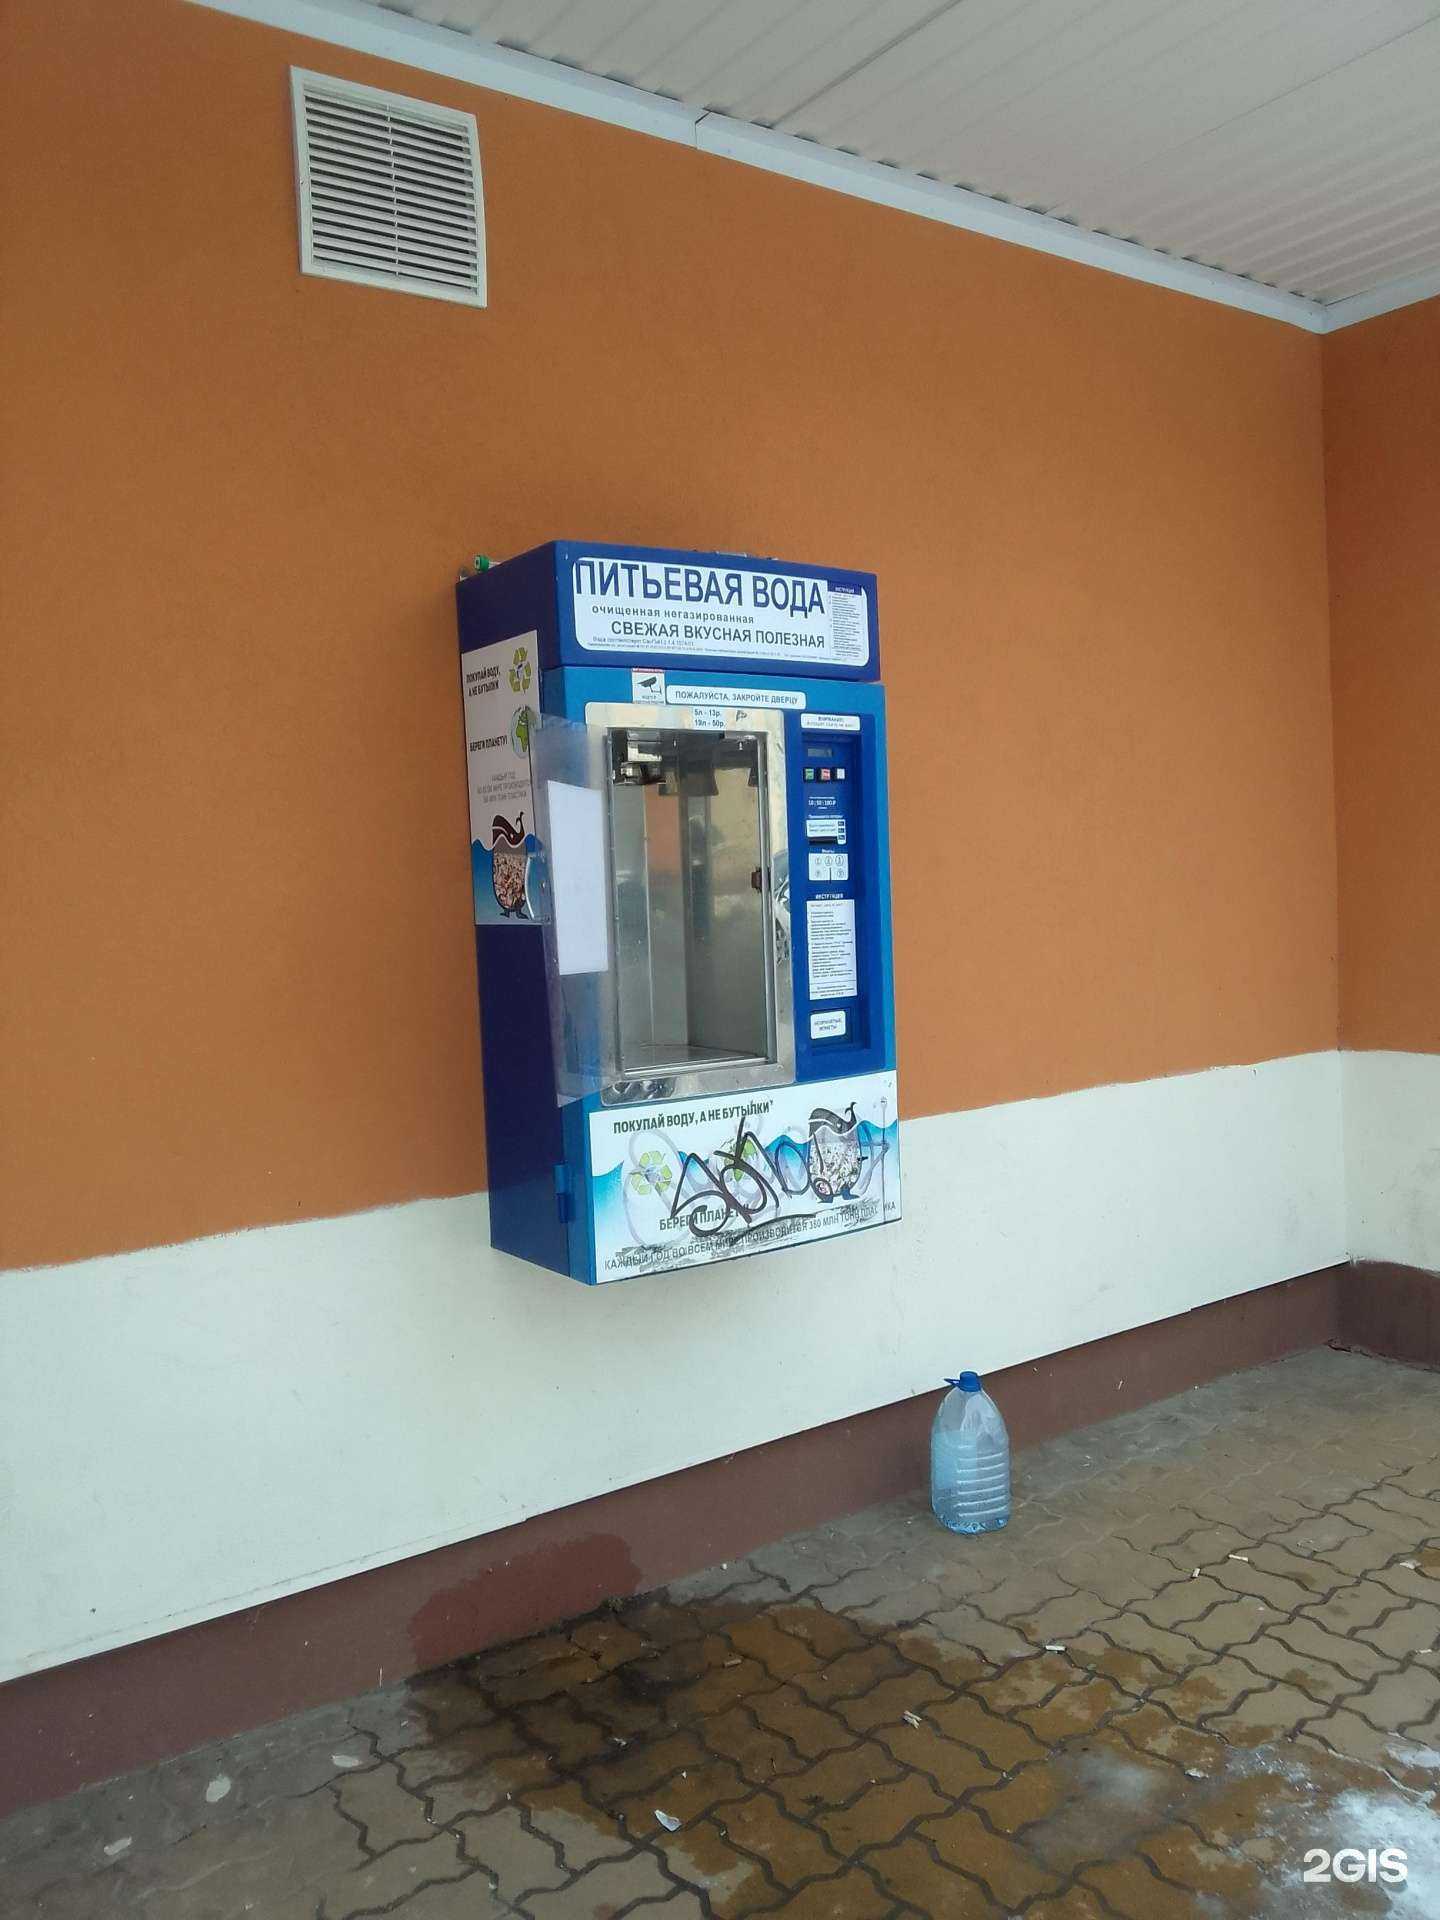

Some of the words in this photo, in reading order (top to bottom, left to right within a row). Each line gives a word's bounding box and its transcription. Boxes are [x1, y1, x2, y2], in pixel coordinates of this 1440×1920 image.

[575, 560, 743, 606] ПИТЬЕВАЯ
[752, 575, 826, 619] ВОДА
[592, 605, 661, 617] очищенная
[664, 609, 754, 624] негазированная
[611, 620, 679, 638] СВЕЖАЯ
[684, 625, 751, 643] ВКУСНАЯ
[756, 630, 825, 648] ПОЛЕЗНАЯ
[675, 690, 729, 702] ПОЖАЛУЙСТА,
[732, 692, 770, 703] ЗАКРОЙТЕ
[771, 696, 798, 705] ДВЕРЦУ
[613, 1114, 665, 1134] ПОКУПАЙ
[666, 1112, 699, 1127] ВОДУ,
[699, 1111, 707, 1122] А
[708, 1109, 721, 1121] НЕ
[823, 1215, 839, 1228] МЛН
